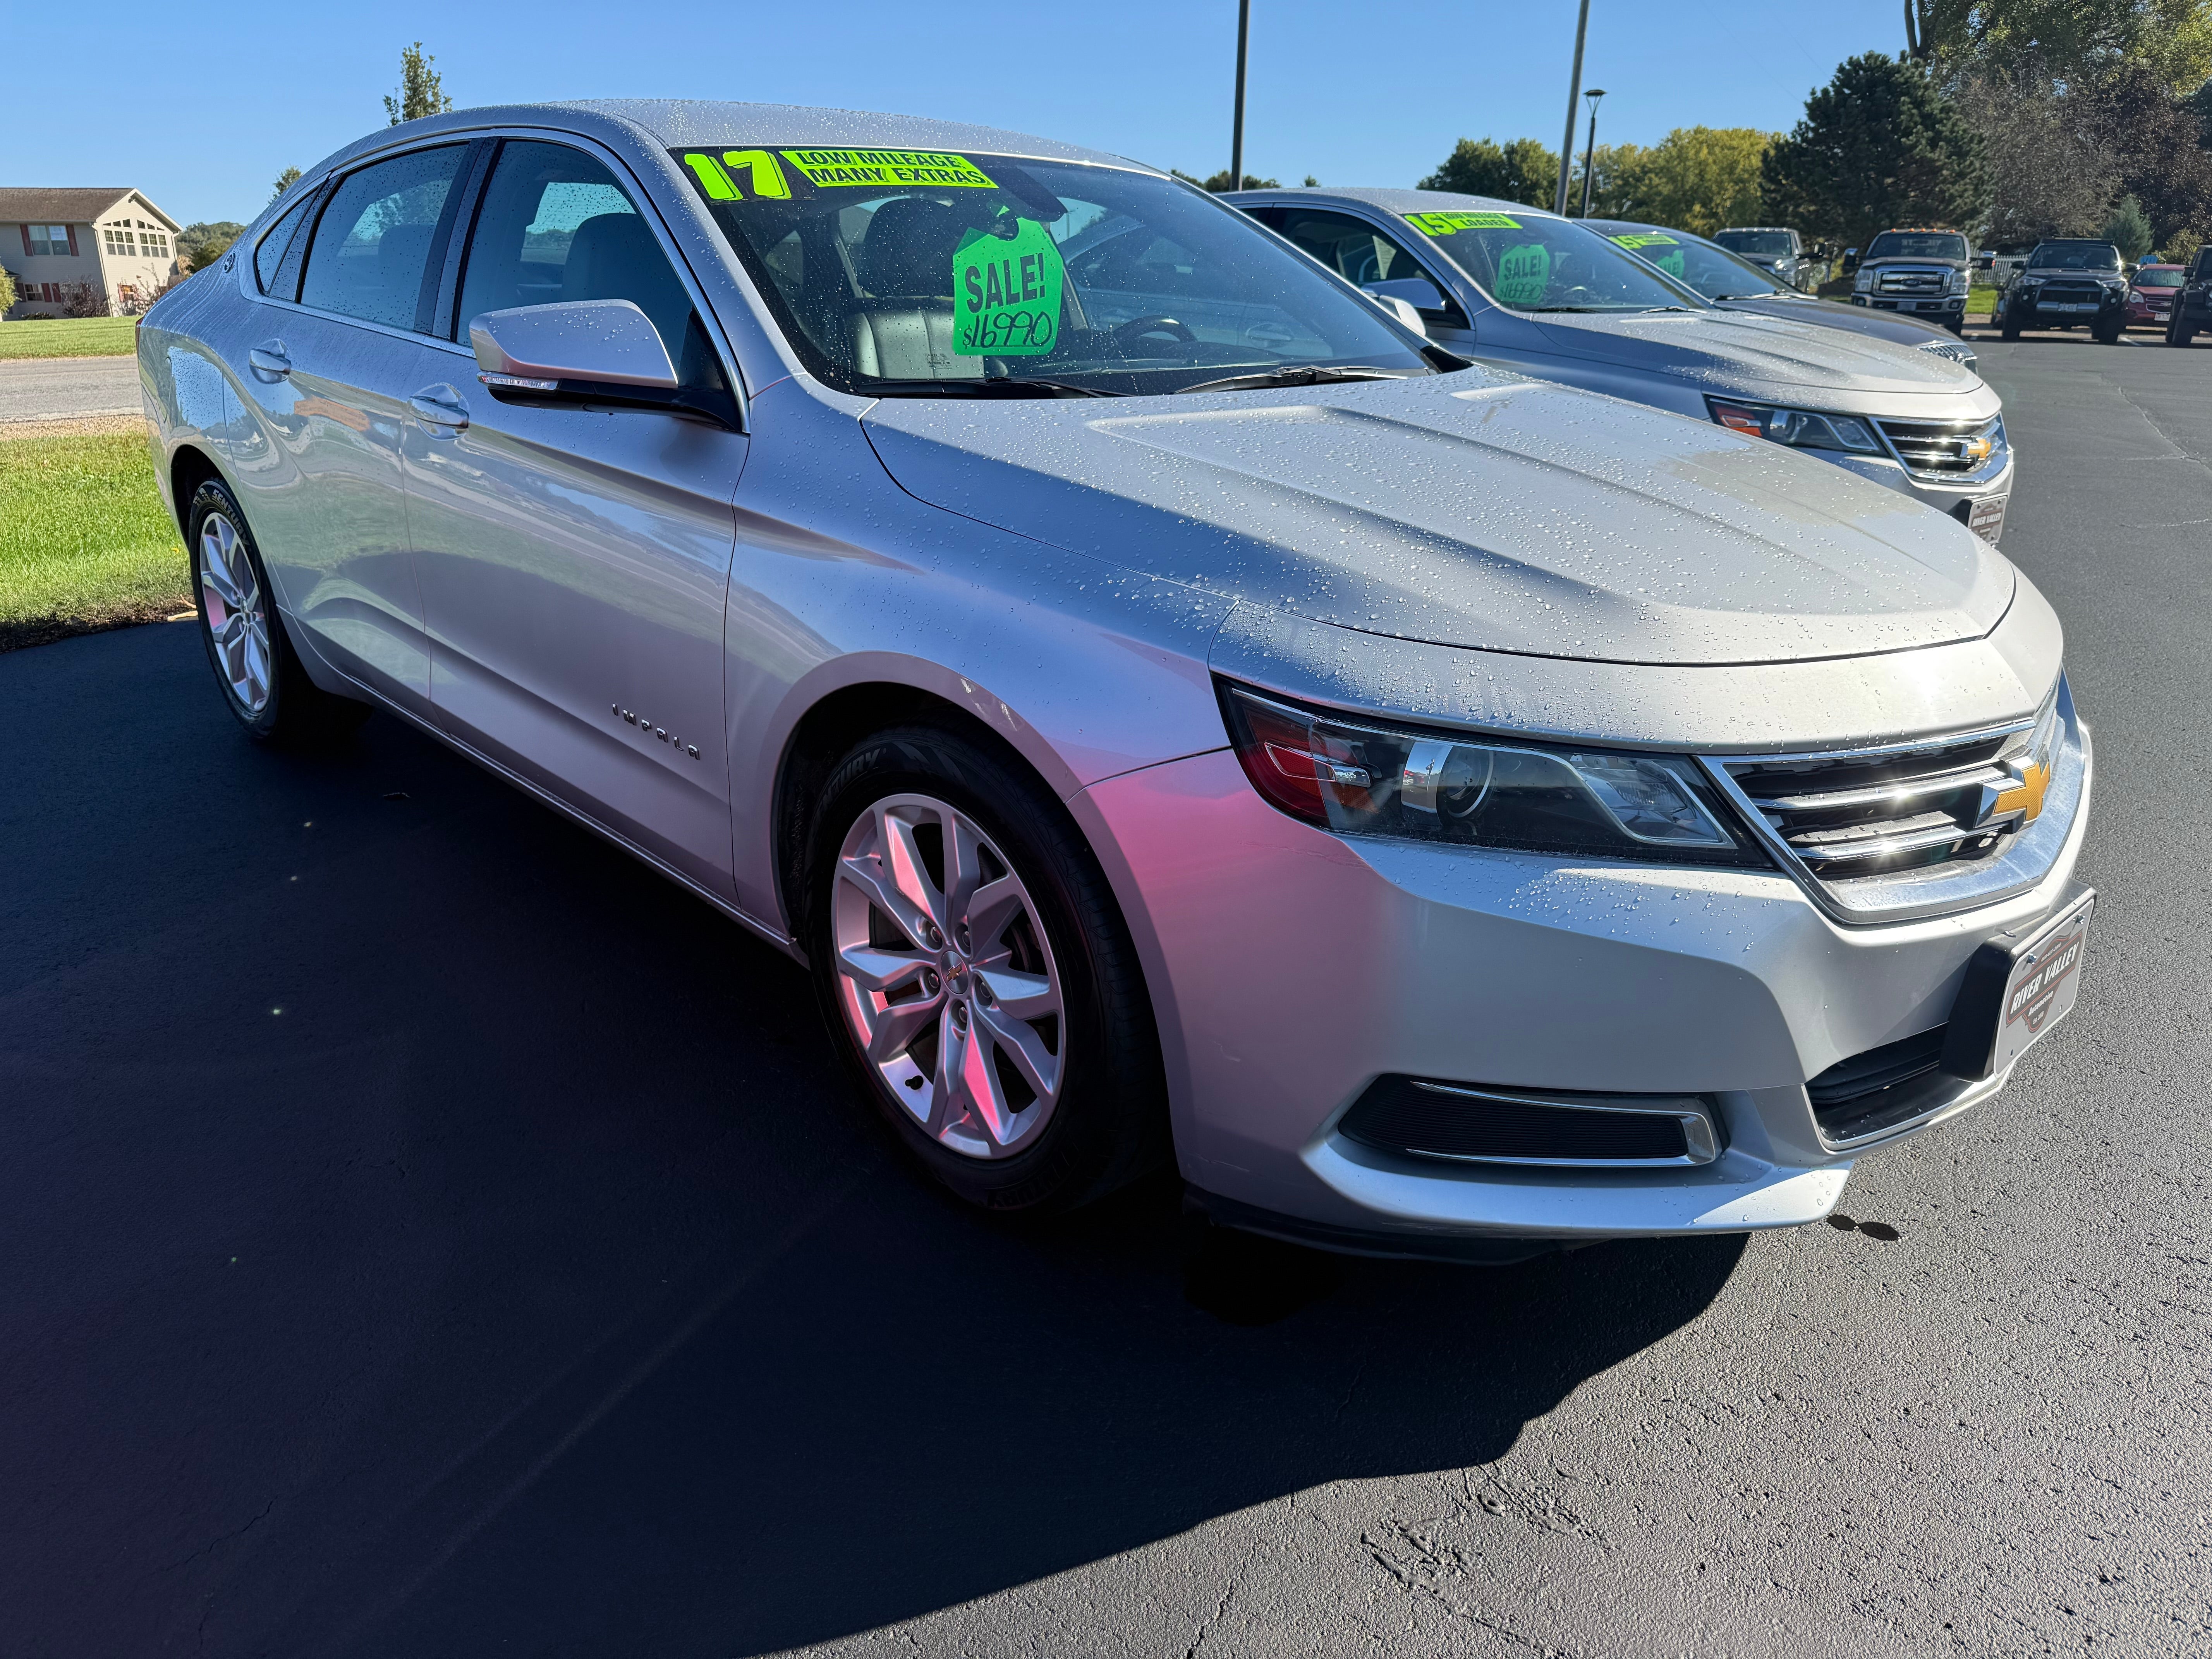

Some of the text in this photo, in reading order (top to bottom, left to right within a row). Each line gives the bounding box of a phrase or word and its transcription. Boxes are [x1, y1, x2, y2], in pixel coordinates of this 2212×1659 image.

[684, 150, 792, 201] 17
[795, 152, 966, 168] LOW MILEAGE
[806, 168, 991, 185] MANY EXTRAS
[1405, 214, 1456, 236] 15
[965, 252, 1045, 313] SALE!
[1504, 255, 1541, 280] SALE!
[963, 311, 1052, 349] $16990
[212, 489, 251, 545] SENTURY
[612, 703, 700, 760] IMPALA
[2010, 973, 2043, 1015] RIVER
[2044, 941, 2079, 985] VALLEY
